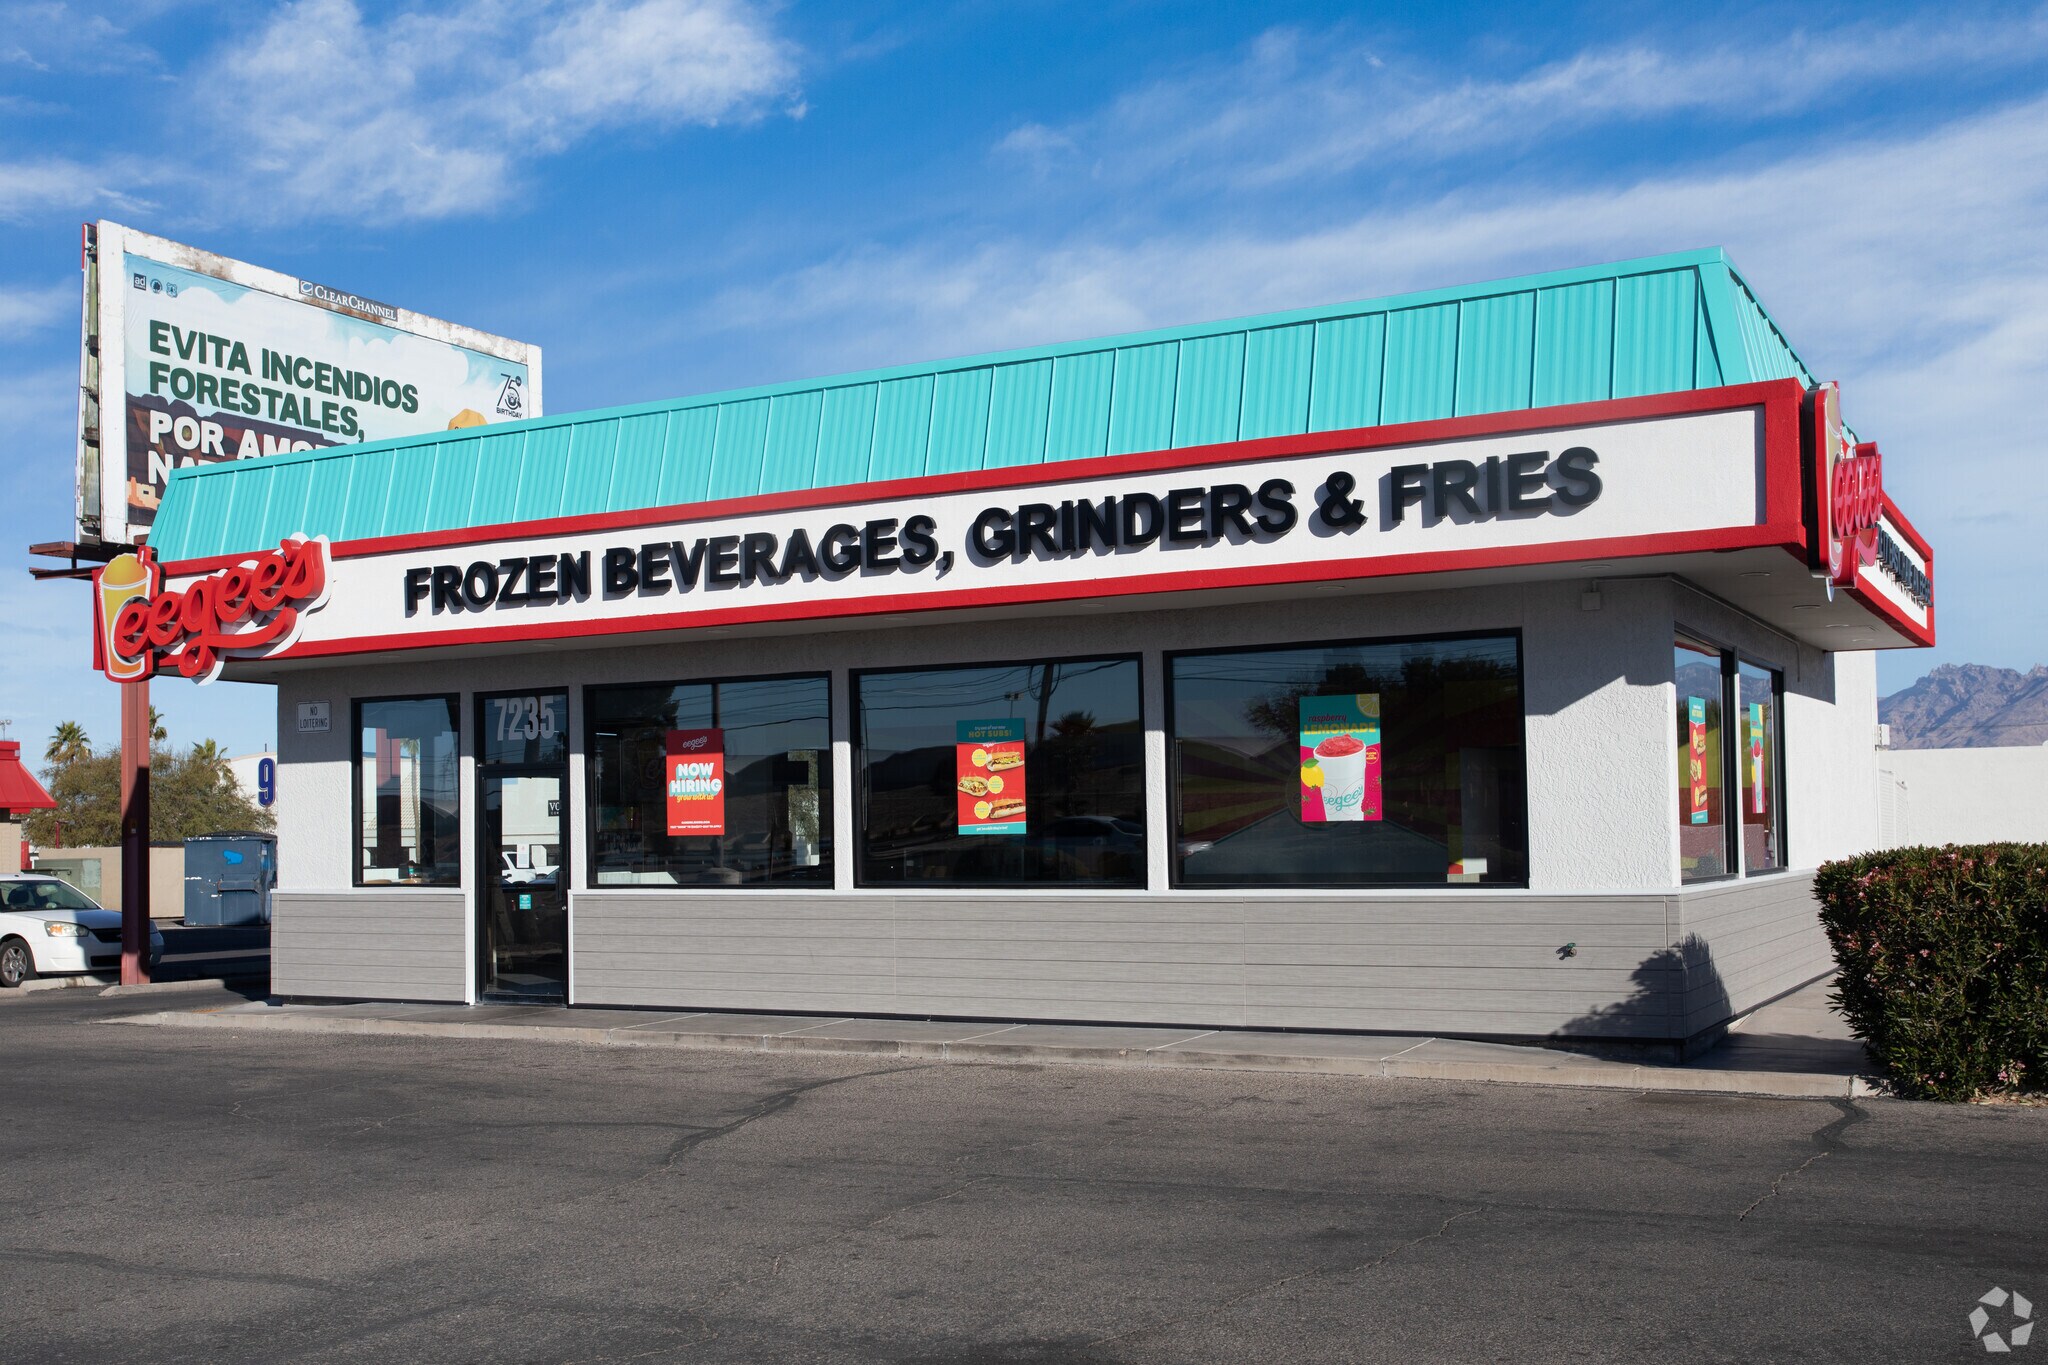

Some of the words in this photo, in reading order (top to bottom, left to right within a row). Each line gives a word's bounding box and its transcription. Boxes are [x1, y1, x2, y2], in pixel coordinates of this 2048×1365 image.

[148, 319, 252, 376] EVITA
[261, 348, 418, 414] INCENDIOS
[148, 361, 365, 443] FORESTALES,
[496, 407, 522, 419] BIRTHDAY
[150, 409, 225, 457] POR
[405, 550, 591, 612] FROZEN
[604, 514, 955, 594] BEVERAGES,
[971, 478, 1298, 559] GRINDERS
[1319, 471, 1364, 528] &
[1388, 446, 1603, 522] FRIES
[113, 538, 326, 677] eegee's
[310, 706, 318, 716] NO
[494, 695, 556, 742] 7235
[1308, 713, 1347, 724] raspberry
[300, 717, 328, 729] LOITERING
[1303, 721, 1376, 735] LEMONADE
[968, 730, 985, 738] HOT
[987, 729, 1012, 737] SUBS!
[677, 762, 715, 777] NOW
[670, 778, 722, 793] HIRING
